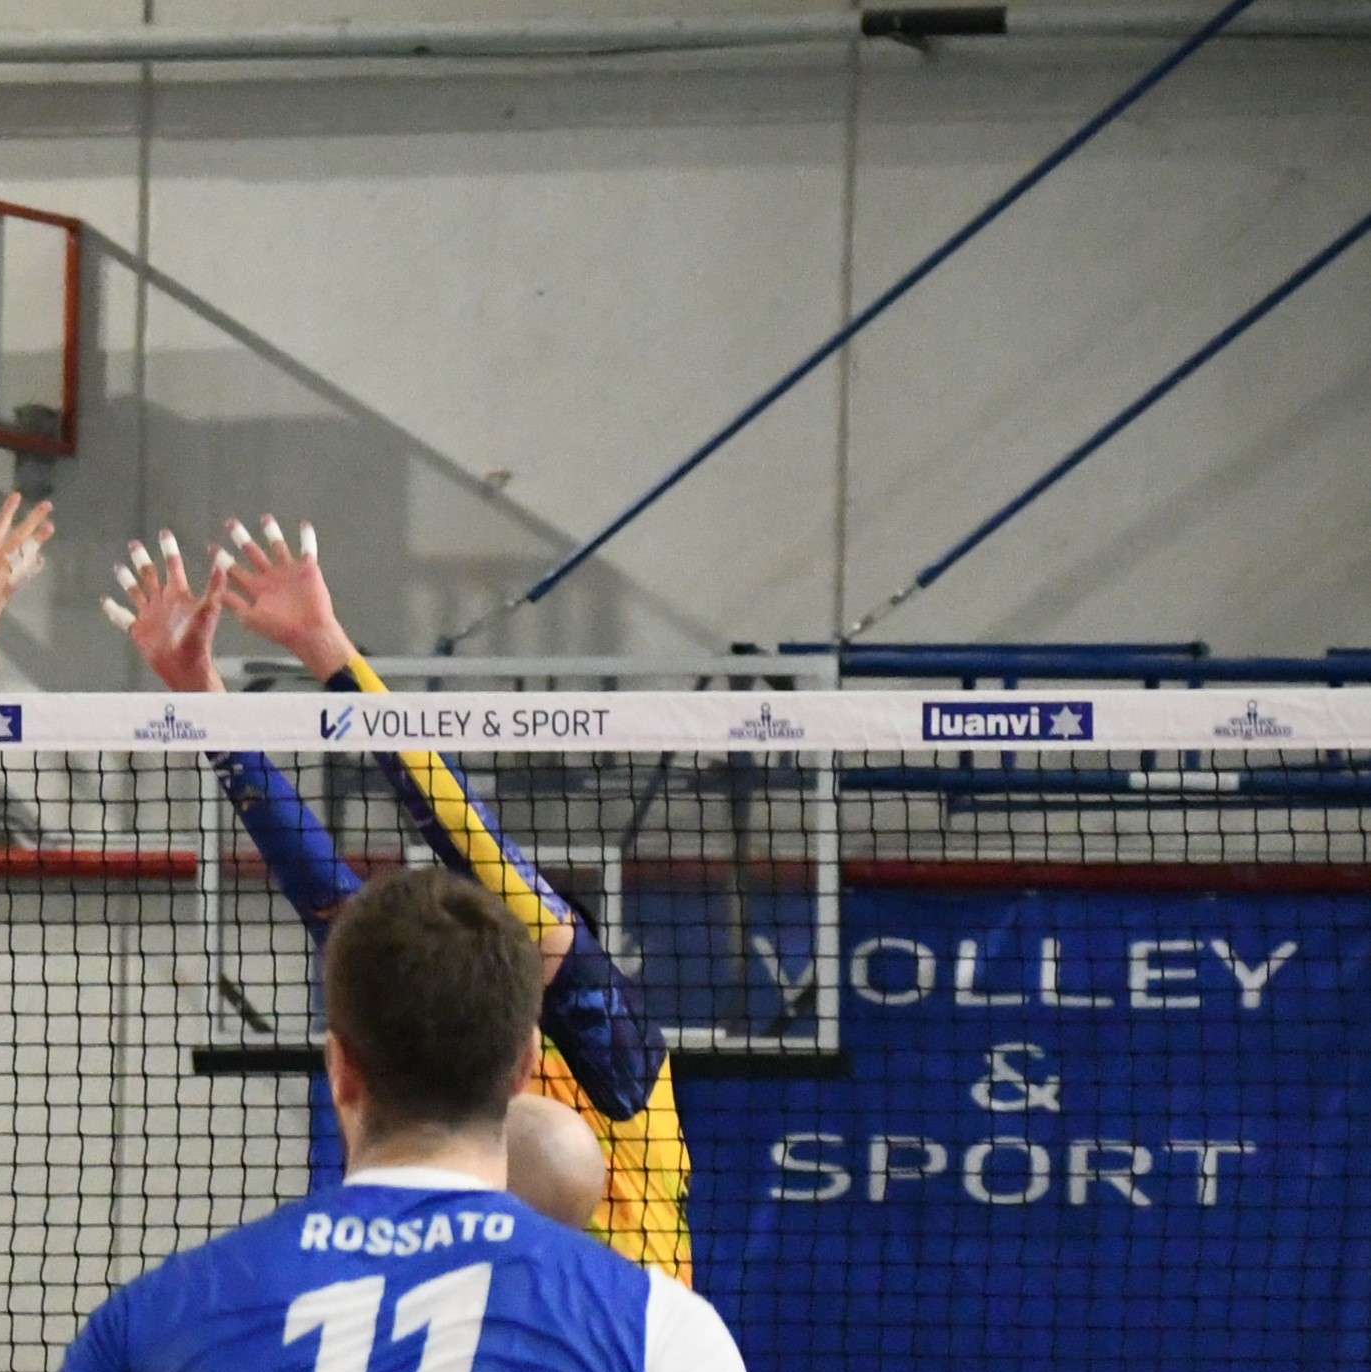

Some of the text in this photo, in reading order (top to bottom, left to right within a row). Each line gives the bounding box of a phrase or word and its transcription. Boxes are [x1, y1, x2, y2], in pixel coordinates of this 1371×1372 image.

[362, 709, 610, 737] VOLLEY & SPORT
[751, 934, 1299, 1011] VOLLEY
[970, 1042, 1063, 1113] &
[770, 1133, 1257, 1208] SPORT
[301, 1210, 516, 1257] ROSSATO
